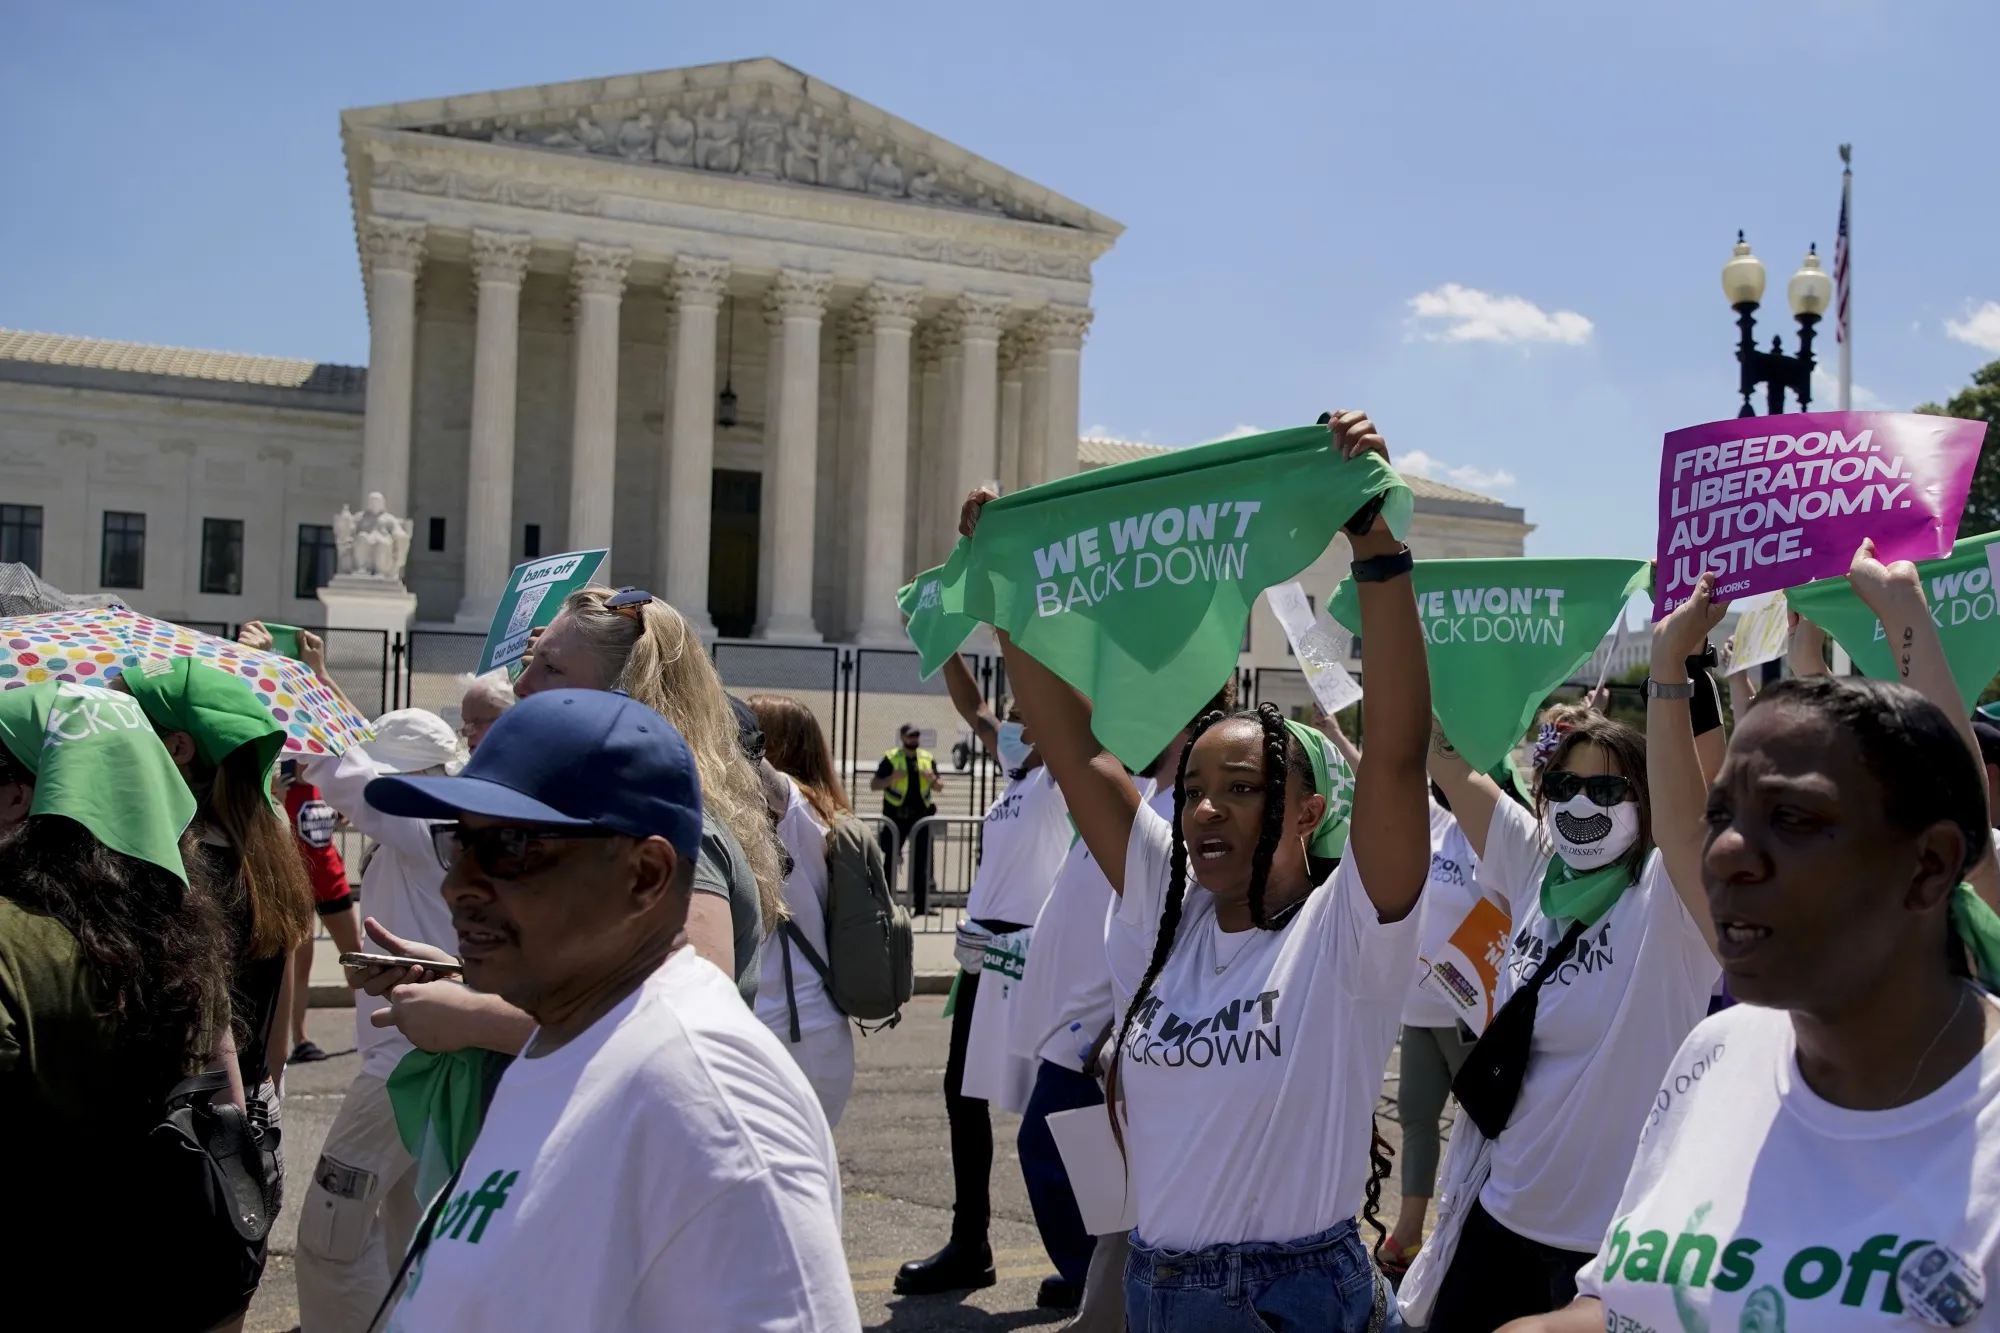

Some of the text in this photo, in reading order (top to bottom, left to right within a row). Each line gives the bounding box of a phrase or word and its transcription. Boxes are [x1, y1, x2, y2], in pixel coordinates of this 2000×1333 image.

[1673, 429, 1881, 482] FREEDOM.
[1671, 455, 1912, 518] LIBERATION.
[1666, 483, 1912, 555] AUTONOMY.
[1033, 501, 1261, 579] WE WON'T
[523, 560, 578, 583] bans off
[1666, 528, 1812, 592] JUSTICE.
[1036, 543, 1249, 618] BACK DOWN
[1716, 580, 1750, 596] WORKS
[1932, 567, 1994, 601] WO
[1452, 587, 1564, 617] WON'T
[1951, 593, 2000, 626] DO
[1420, 616, 1564, 646] ACK DOWN
[494, 647, 506, 660] our
[1568, 847, 1604, 856] DISSENT
[1603, 1216, 1763, 1292] bans
